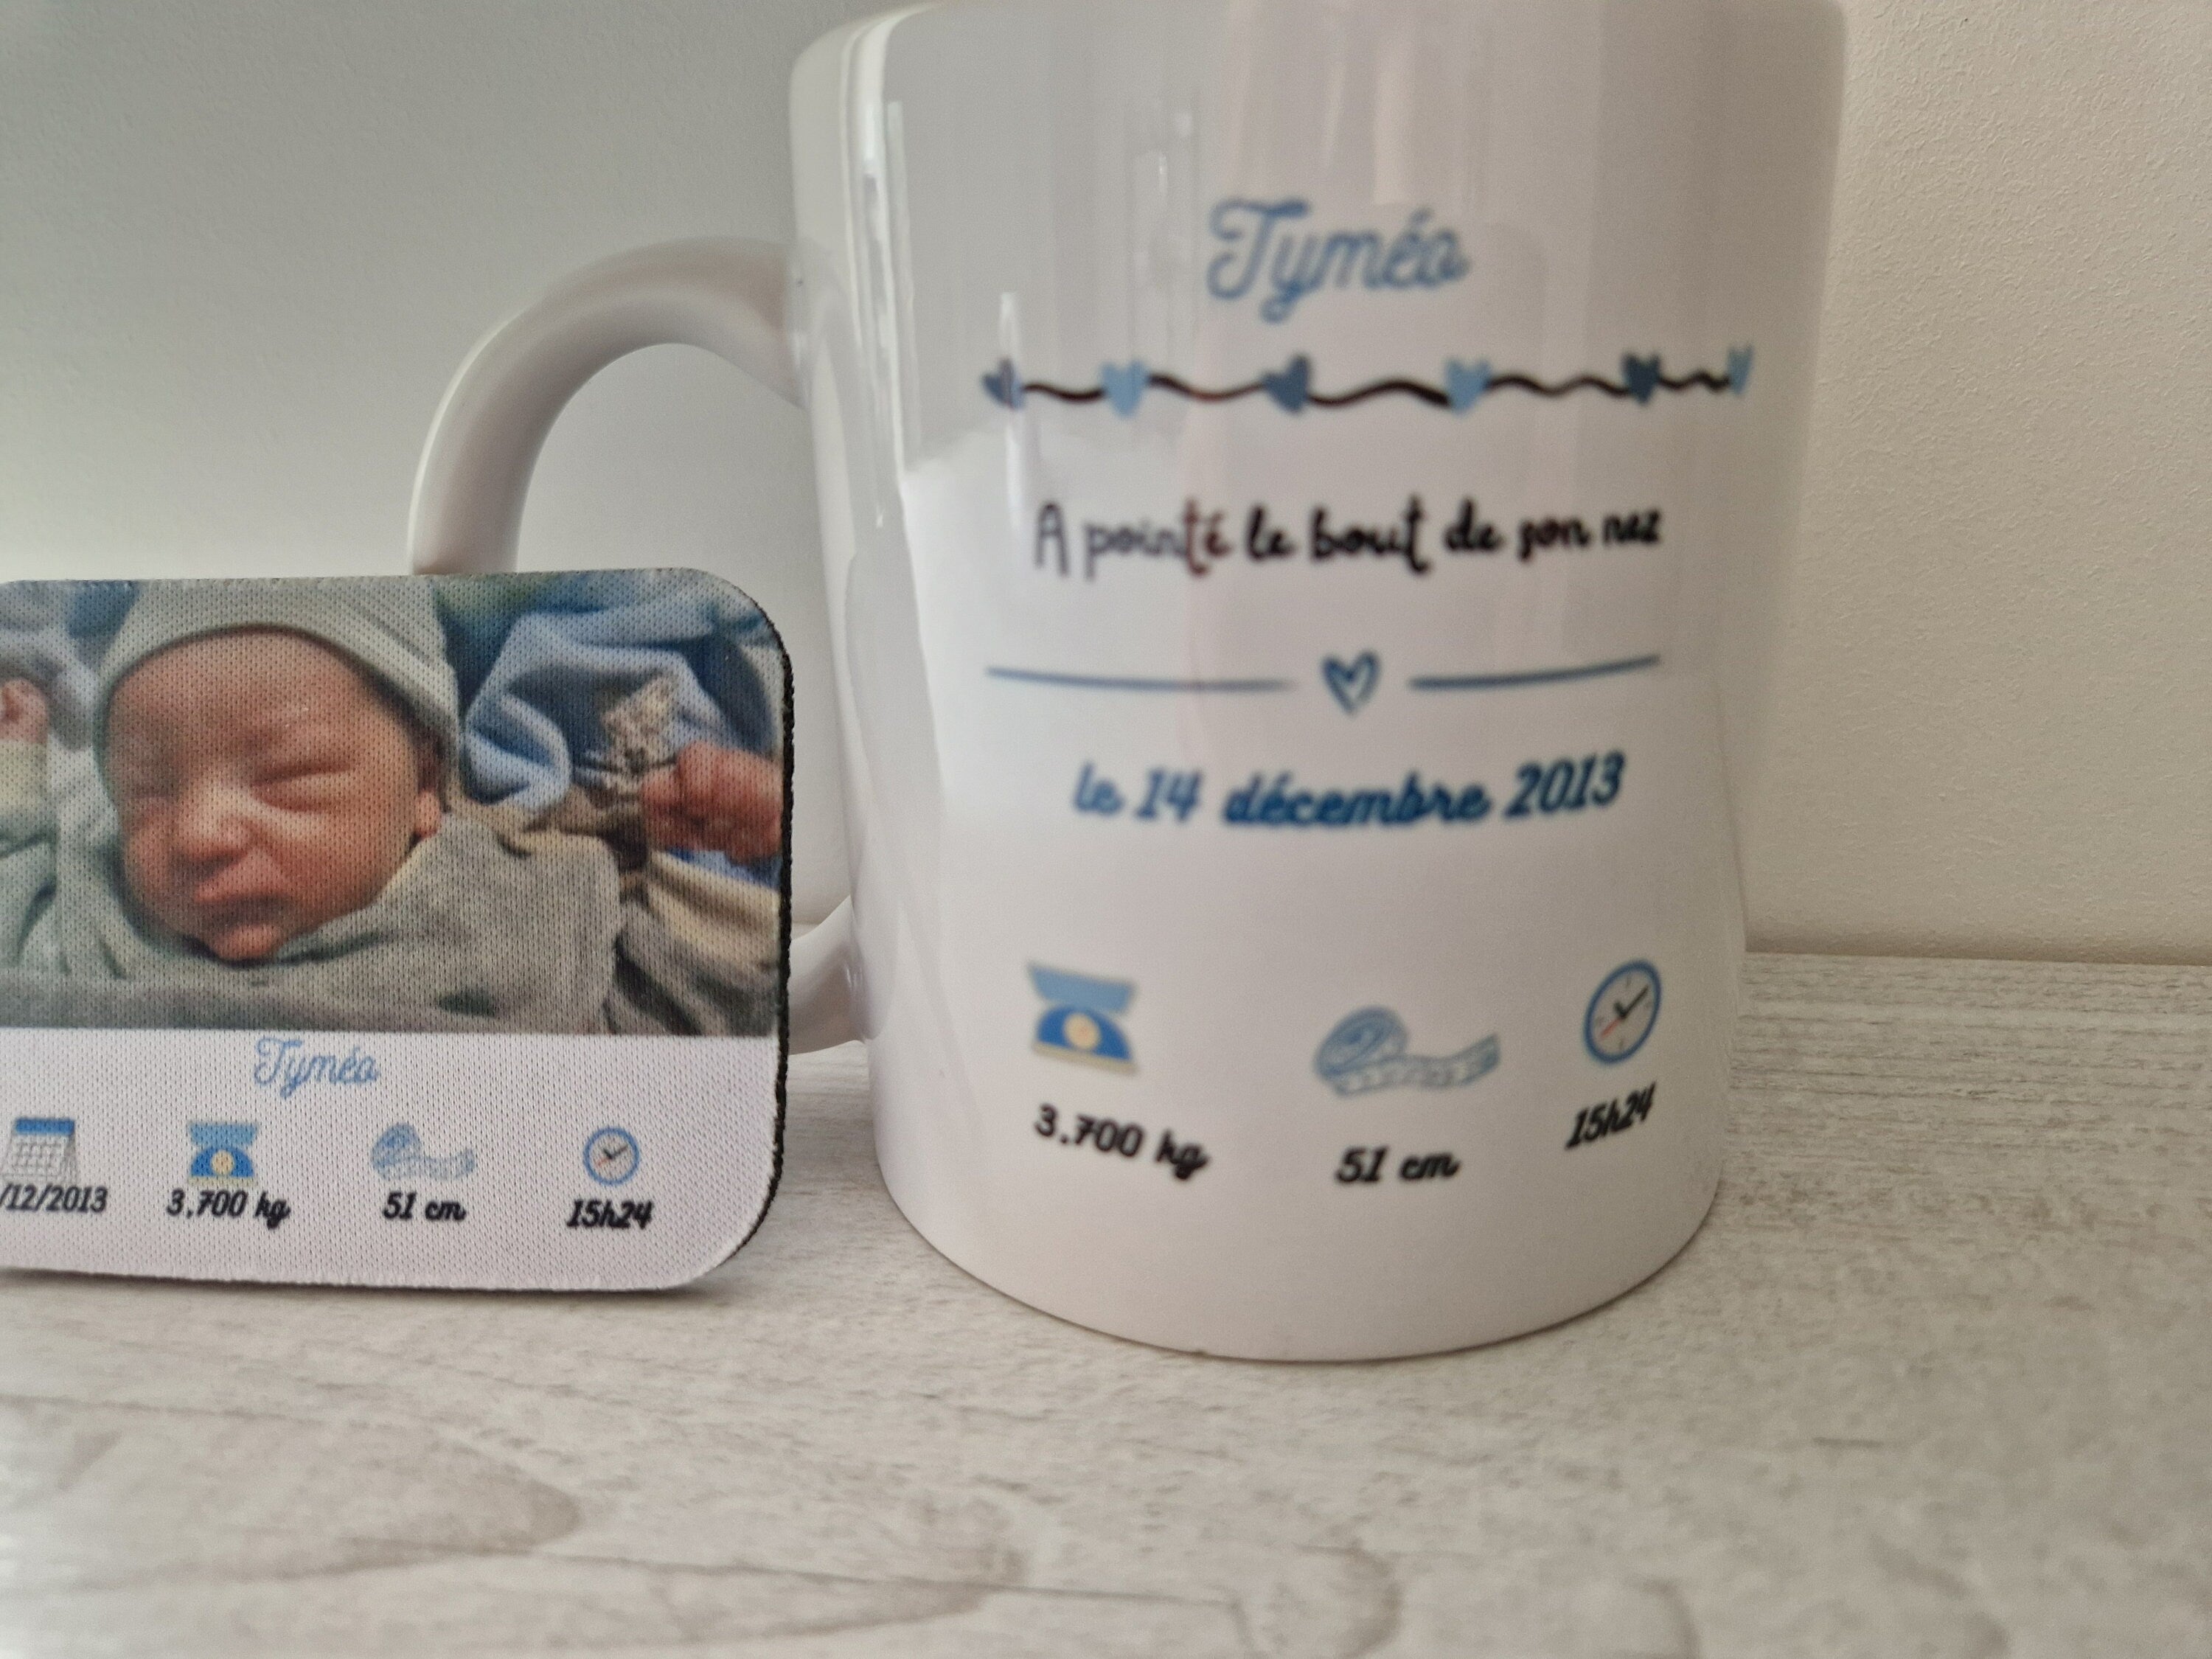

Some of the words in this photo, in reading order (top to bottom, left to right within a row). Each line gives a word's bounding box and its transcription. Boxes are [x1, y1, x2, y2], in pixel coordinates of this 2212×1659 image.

[1207, 198, 1470, 324] Tyméa
[1035, 503, 1069, 578] A
[1085, 495, 1233, 580] pointé
[1245, 507, 1293, 562] le
[1310, 495, 1430, 574] bout
[1444, 498, 1501, 554] de
[1073, 762, 1124, 817] le
[1134, 769, 1202, 824] 14
[1222, 773, 1491, 827] décembre
[1505, 752, 1627, 820] 2013
[254, 1037, 380, 1099] Tyméa
[1034, 1104, 1144, 1159] 3.700
[1156, 1130, 1211, 1181] kg
[1565, 1082, 1658, 1150] 15h24
[1335, 1147, 1389, 1184] 51
[1398, 1150, 1460, 1181] cm
[253, 1192, 292, 1230] kg
[383, 1192, 416, 1221] 51
[423, 1196, 467, 1224] cm
[566, 1198, 653, 1230] 15h24
